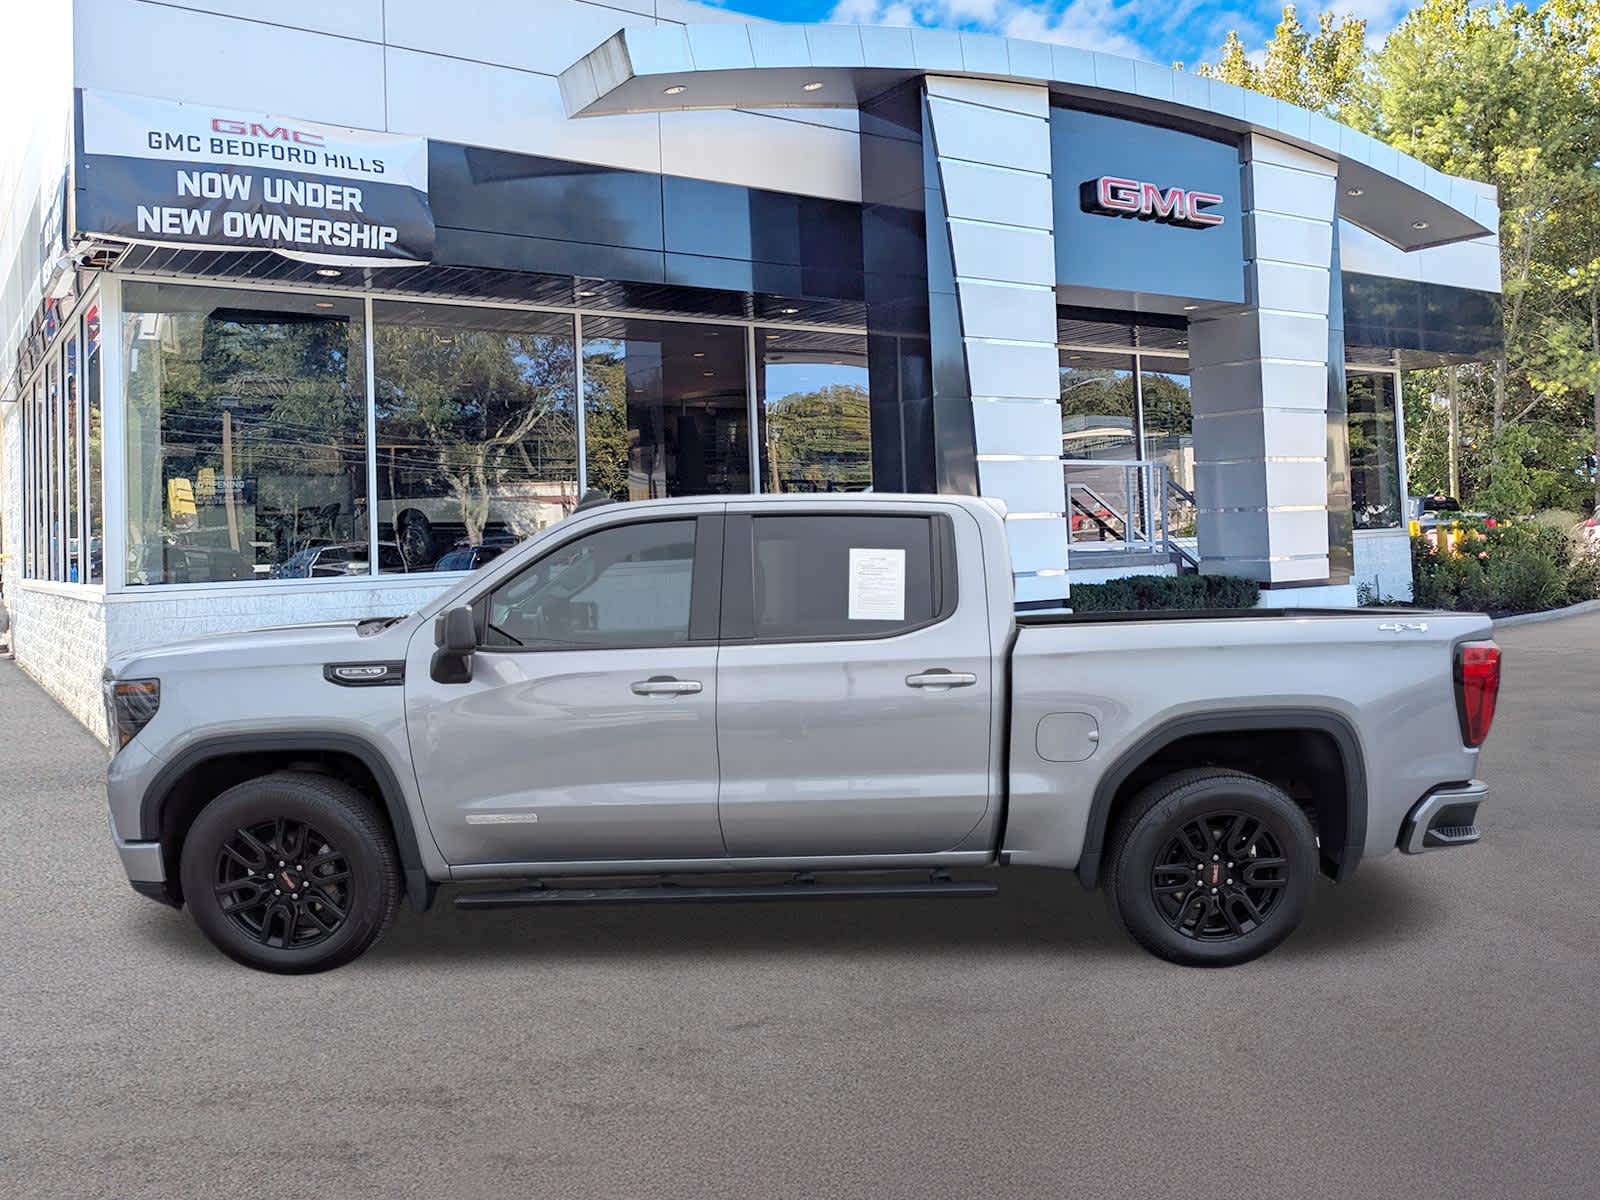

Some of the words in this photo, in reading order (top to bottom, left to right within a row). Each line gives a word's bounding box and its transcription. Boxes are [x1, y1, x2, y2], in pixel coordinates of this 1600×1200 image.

[147, 131, 201, 152] GMC
[209, 137, 317, 165] BEDFORD
[324, 152, 385, 174] HILLS
[210, 118, 326, 149] GMC
[176, 170, 252, 201] NOW
[263, 177, 363, 213] UNDER
[1097, 175, 1225, 225] GMC
[136, 205, 211, 236] NEW
[223, 211, 398, 250] OWNERSHIP
